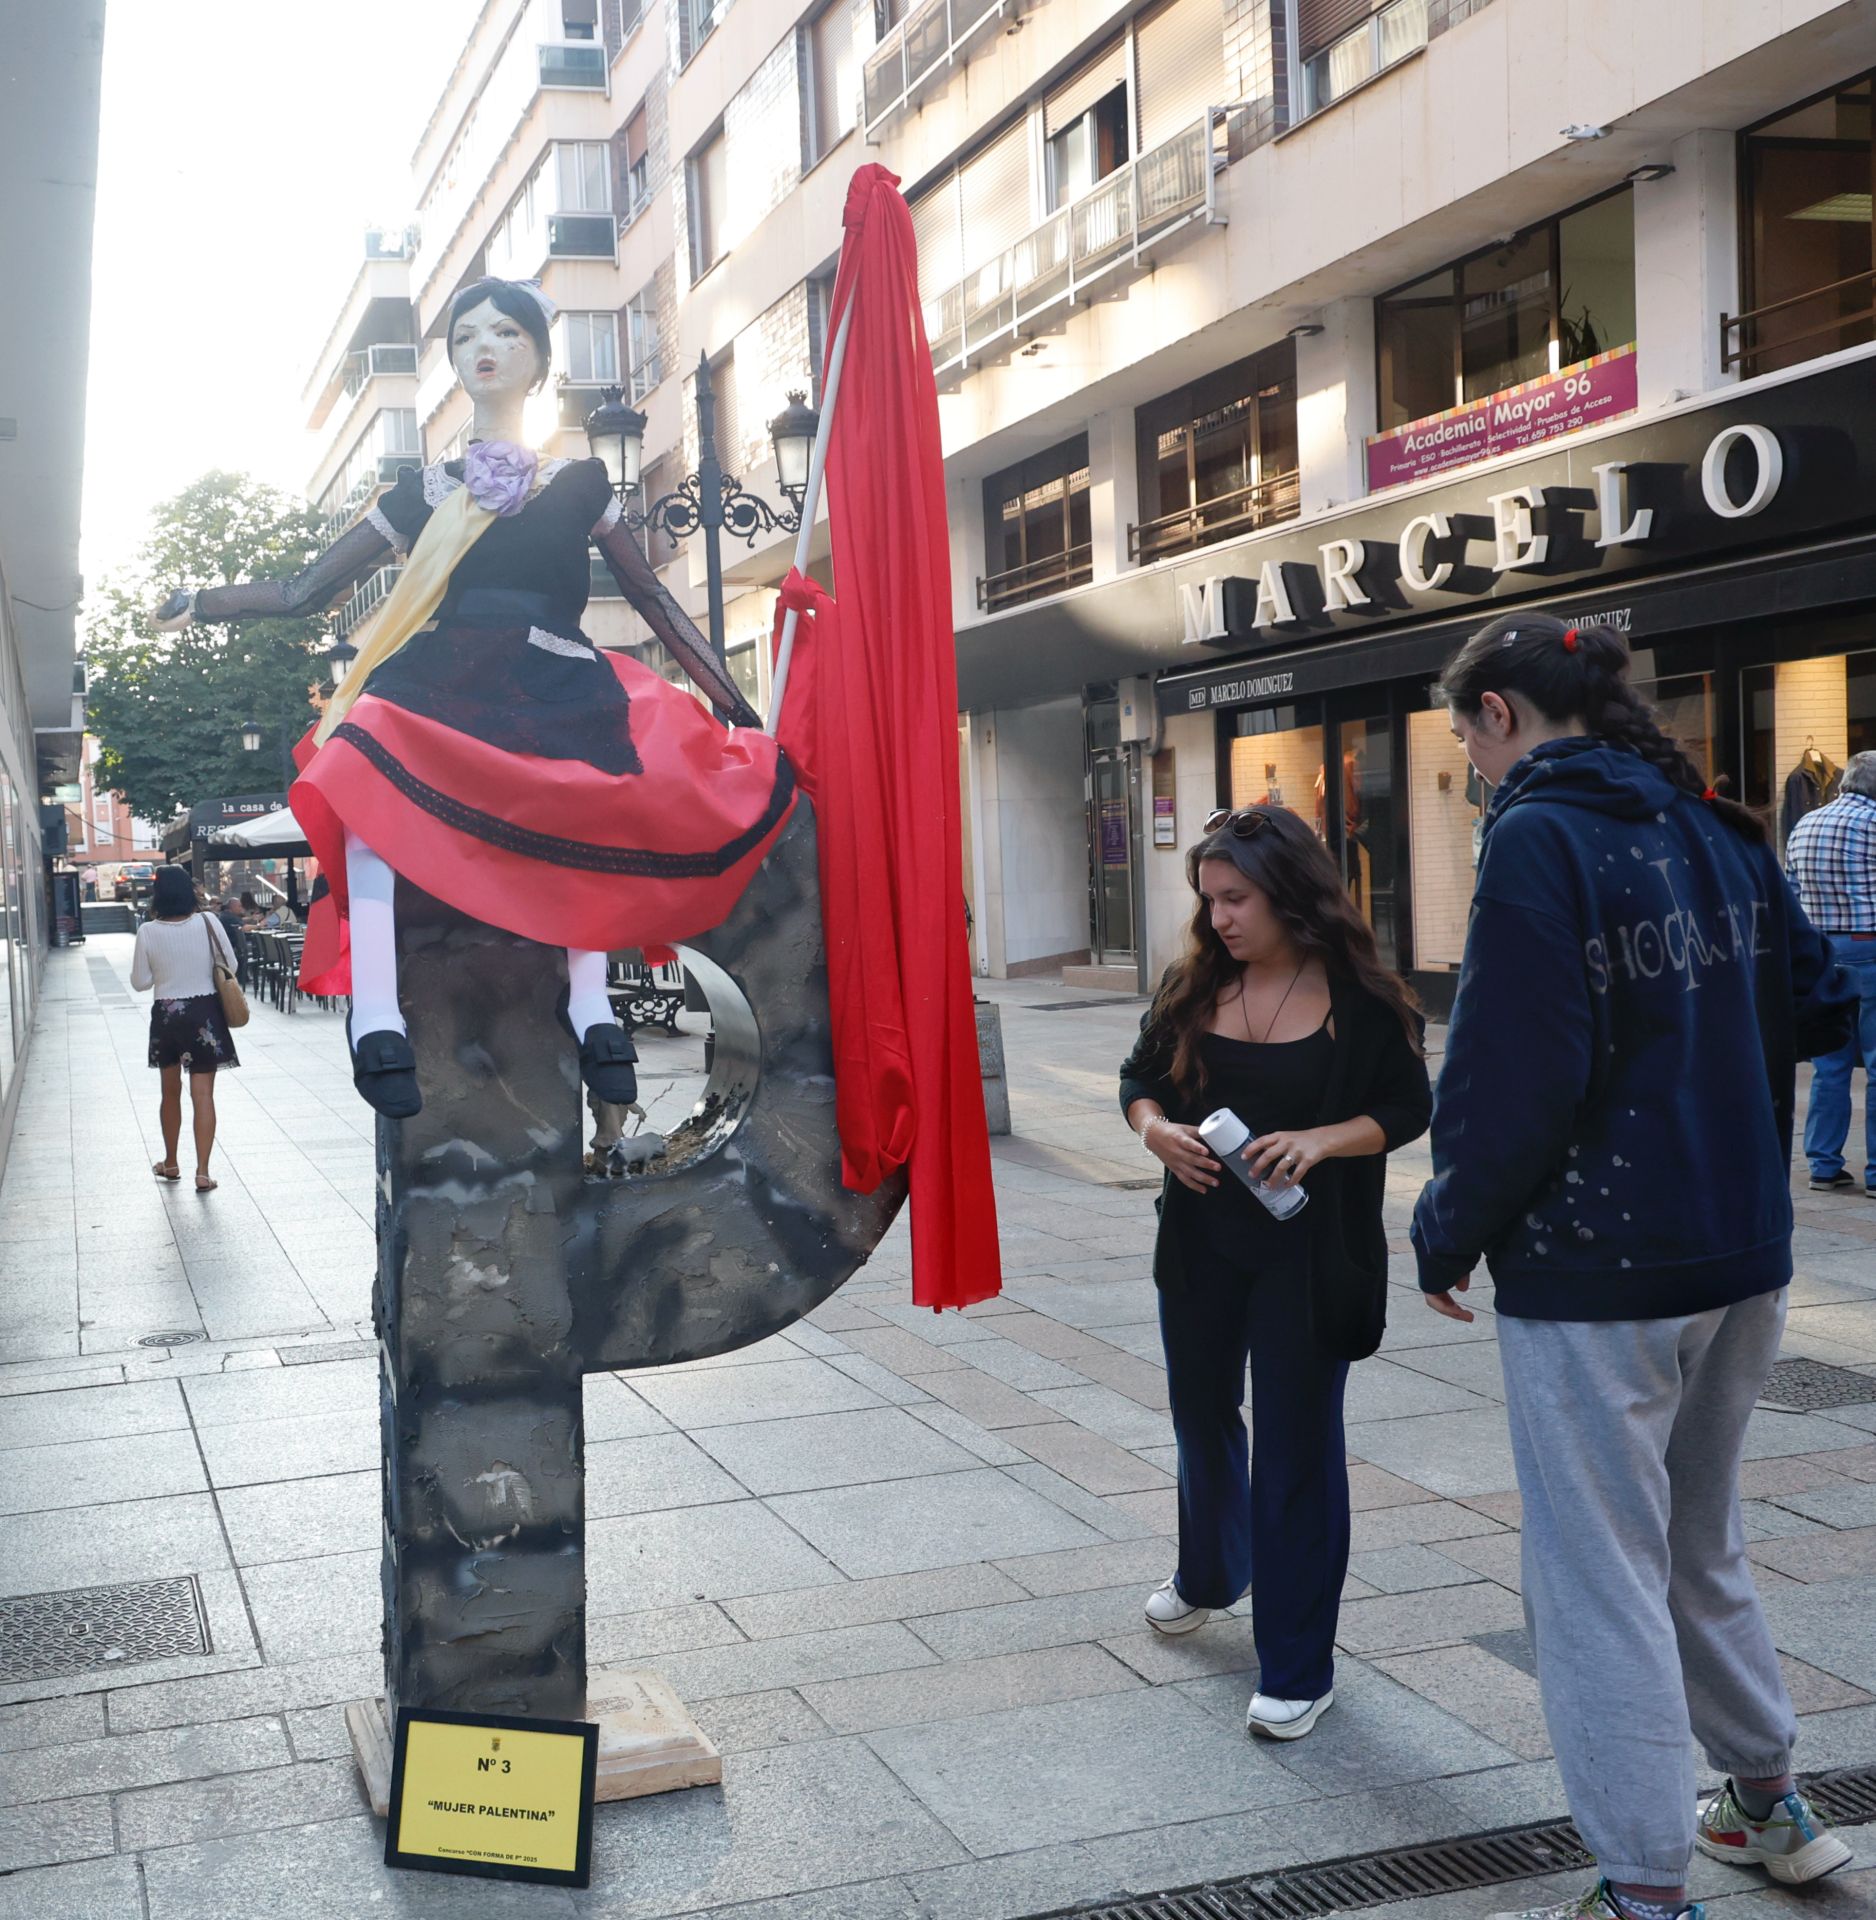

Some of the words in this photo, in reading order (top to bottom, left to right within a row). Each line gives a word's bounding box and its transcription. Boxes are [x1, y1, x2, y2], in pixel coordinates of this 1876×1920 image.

[1404, 415, 1486, 454] Academia
[1494, 391, 1556, 427] Mayor
[1564, 373, 1592, 401] 96
[1390, 459, 1417, 473] Primaria
[1421, 453, 1437, 464] ESO
[1440, 439, 1482, 457] Bachillerato
[1488, 422, 1532, 443] Selectividad
[1537, 411, 1568, 427] Pruebas
[1571, 405, 1581, 416] de
[1584, 395, 1613, 411] Acceso
[1414, 445, 1502, 476] www.academiamayor96.es
[1549, 423, 1565, 435] 753
[1567, 416, 1584, 428] 290
[1179, 423, 1784, 645] MARCELO
[1567, 607, 1632, 632] OMINGUEZ
[1210, 681, 1246, 704] MARCELO
[1246, 672, 1294, 698] DOMINGUEZ
[222, 802, 235, 813] la
[240, 803, 265, 813] casa
[270, 801, 283, 811] de
[501, 1760, 512, 1774] 3
[428, 1800, 476, 1815] “MUJER
[478, 1805, 556, 1822] PALENTINA”
[438, 1846, 465, 1855] Concurso
[483, 1851, 505, 1859] FORMA
